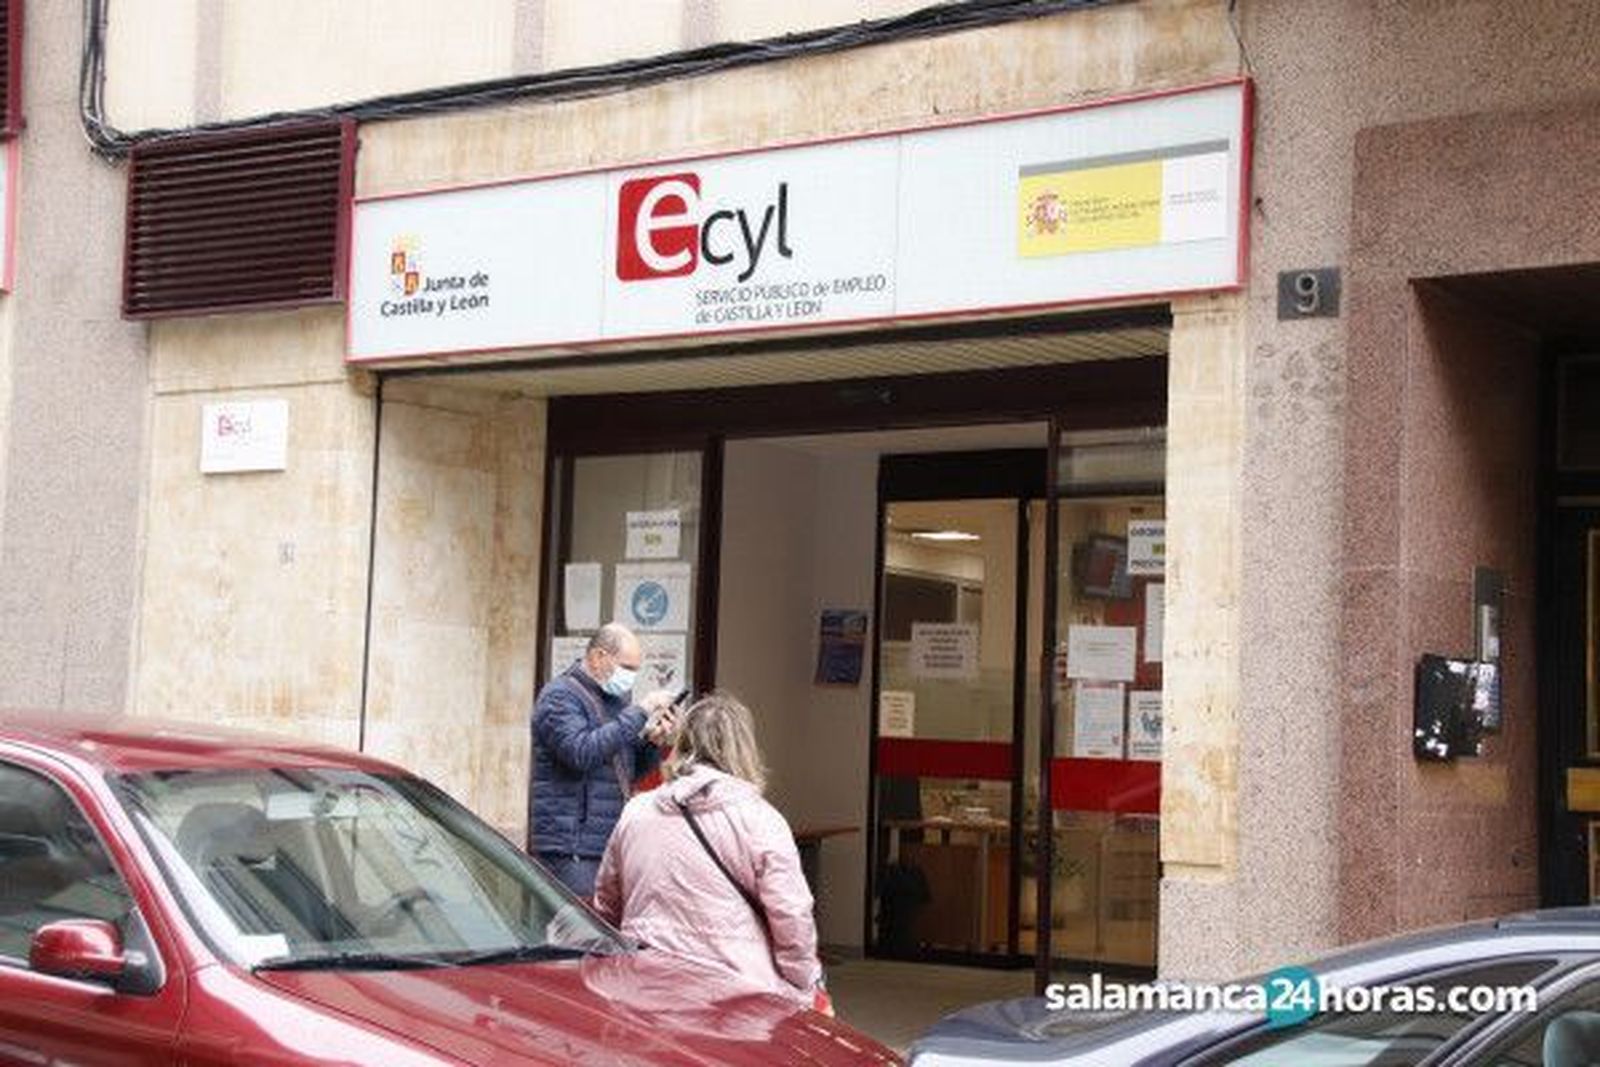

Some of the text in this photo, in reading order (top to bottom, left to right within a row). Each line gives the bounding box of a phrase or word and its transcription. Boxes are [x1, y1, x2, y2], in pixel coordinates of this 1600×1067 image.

[634, 178, 793, 283] ecyl
[423, 270, 489, 292] Junta de
[695, 287, 752, 306] SERVICIO
[813, 281, 829, 297] de
[833, 274, 887, 294] EMPLEO
[1295, 272, 1319, 314] 9
[380, 298, 434, 317] Castilla
[437, 299, 447, 317] y
[695, 308, 713, 324] de
[714, 303, 772, 323] CASTILLA
[774, 303, 784, 318] Y
